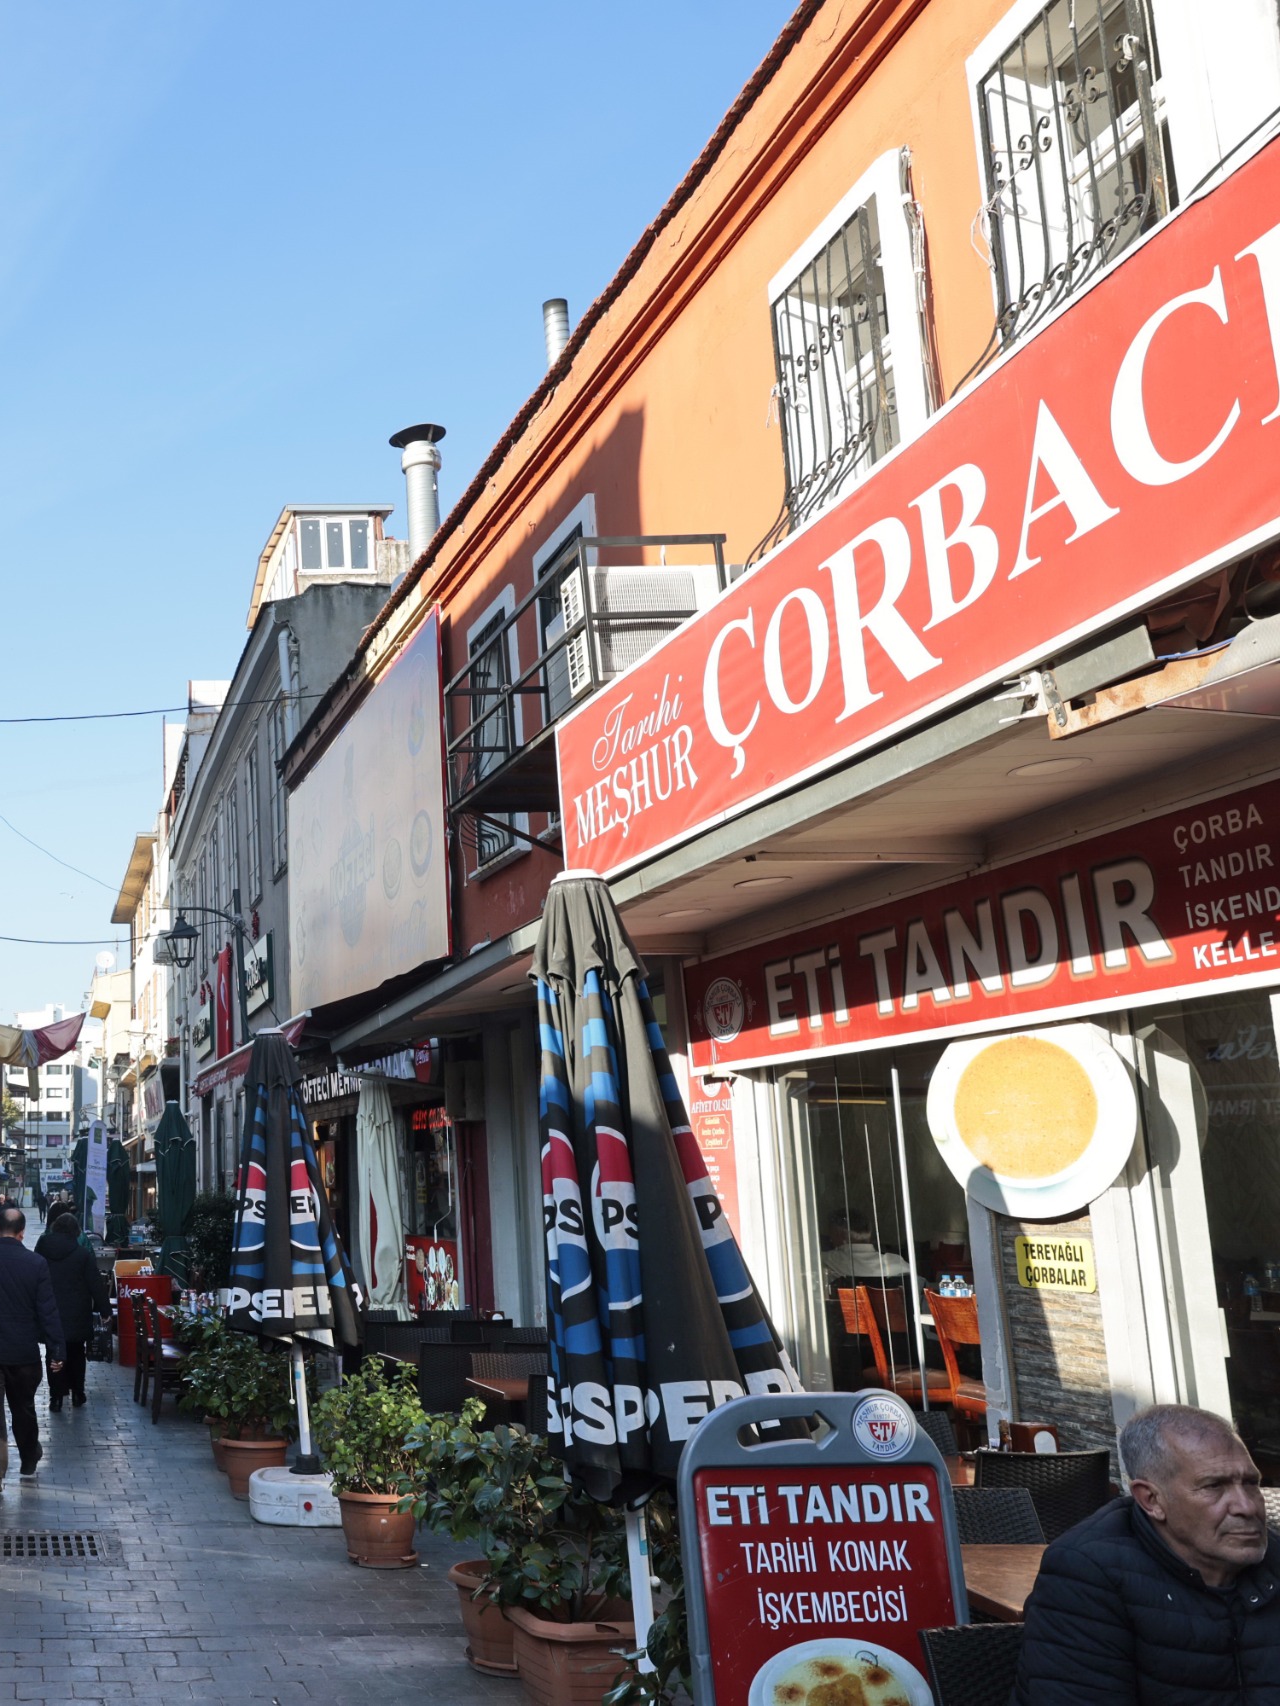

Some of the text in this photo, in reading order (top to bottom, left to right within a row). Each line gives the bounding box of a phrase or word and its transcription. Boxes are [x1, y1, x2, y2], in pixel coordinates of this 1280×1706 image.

[592, 675, 683, 769] Tarihi
[573, 725, 698, 840] MEŞHUR
[1173, 803, 1264, 854] ÇORBA
[1178, 843, 1275, 888] TANDIR
[859, 857, 1174, 1015] TANDIR
[1193, 931, 1278, 970] KELLE
[300, 1066, 329, 1104] ÖFTECİ
[1022, 1239, 1085, 1263] TEREYAĞLI
[1024, 1266, 1088, 1291] ÇORBALAR
[871, 1440, 897, 1452] TANDIR
[778, 1482, 934, 1525] TANDIR
[740, 1536, 912, 1575] TARİHİ KONAK
[757, 1584, 909, 1631] İŞKEMBECİSİ
